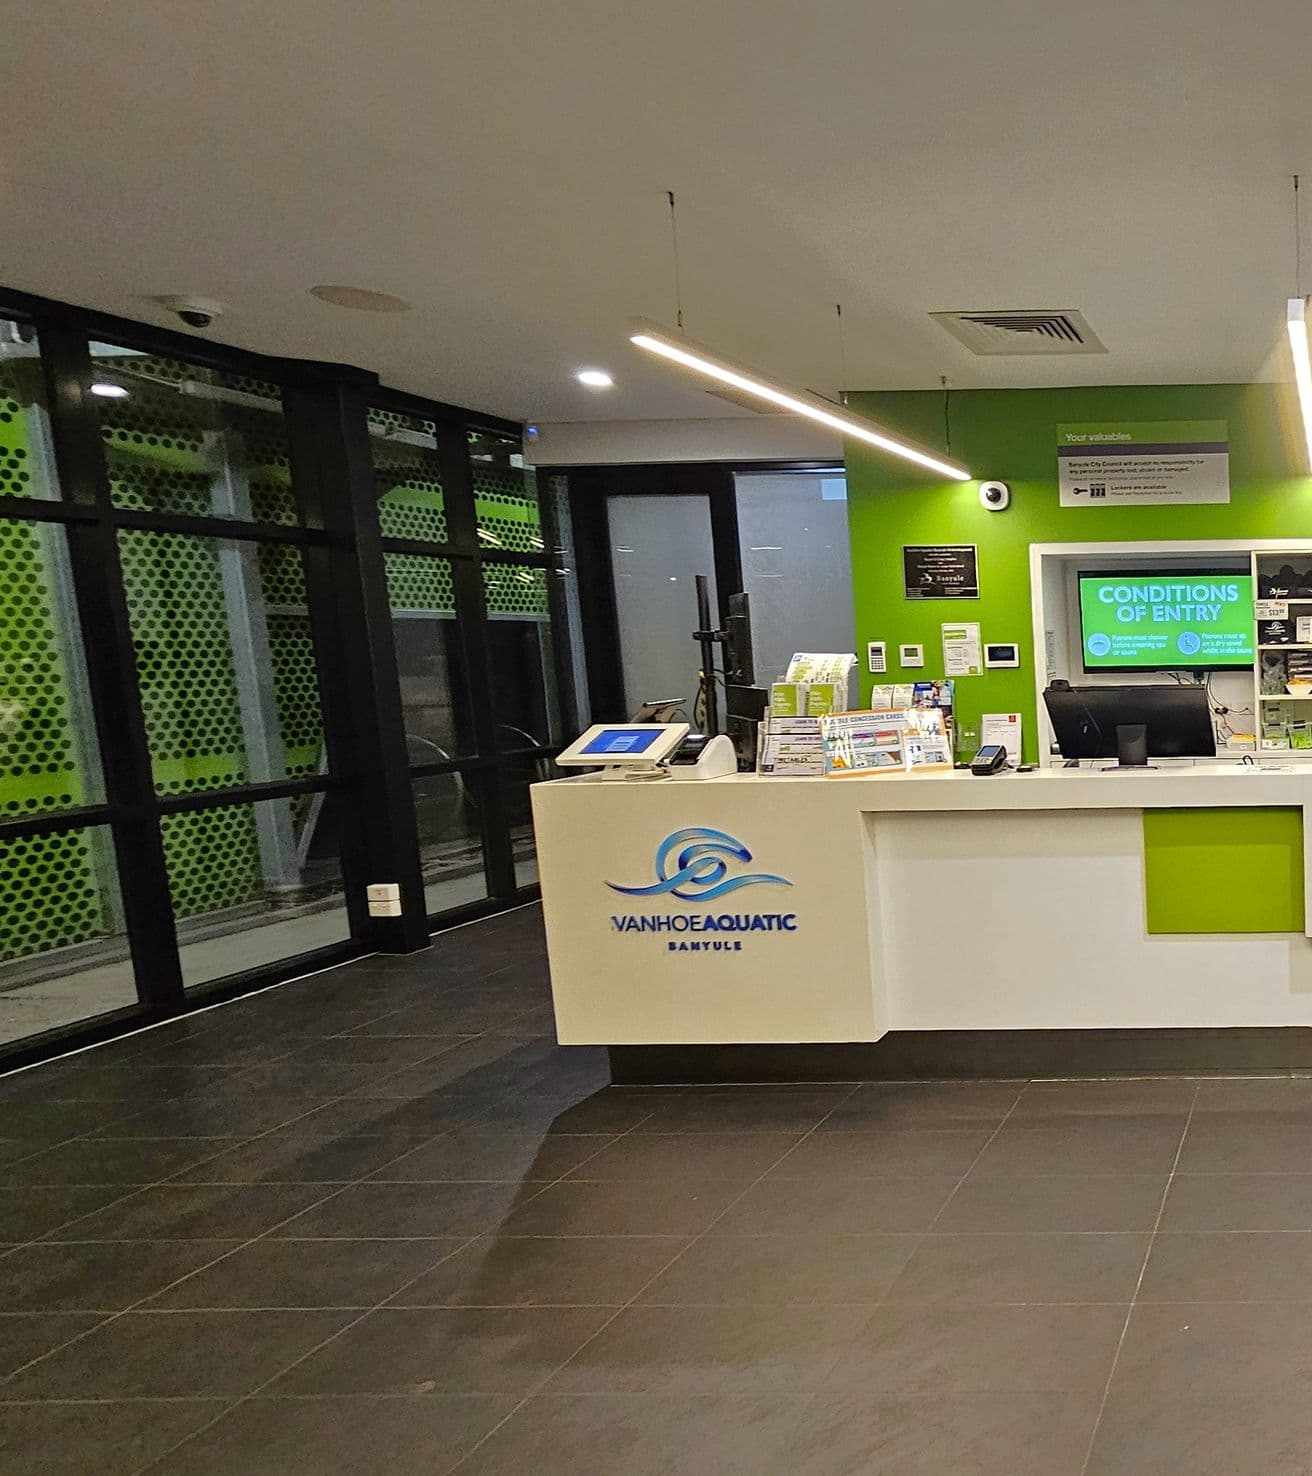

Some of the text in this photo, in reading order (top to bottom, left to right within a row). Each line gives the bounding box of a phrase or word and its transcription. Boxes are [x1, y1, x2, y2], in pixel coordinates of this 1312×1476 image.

[1066, 432, 1132, 441] Your valuables
[1099, 584, 1239, 603] CONDITIONS
[1116, 604, 1222, 622] OF ENTRY
[668, 942, 742, 951] BANYULE
